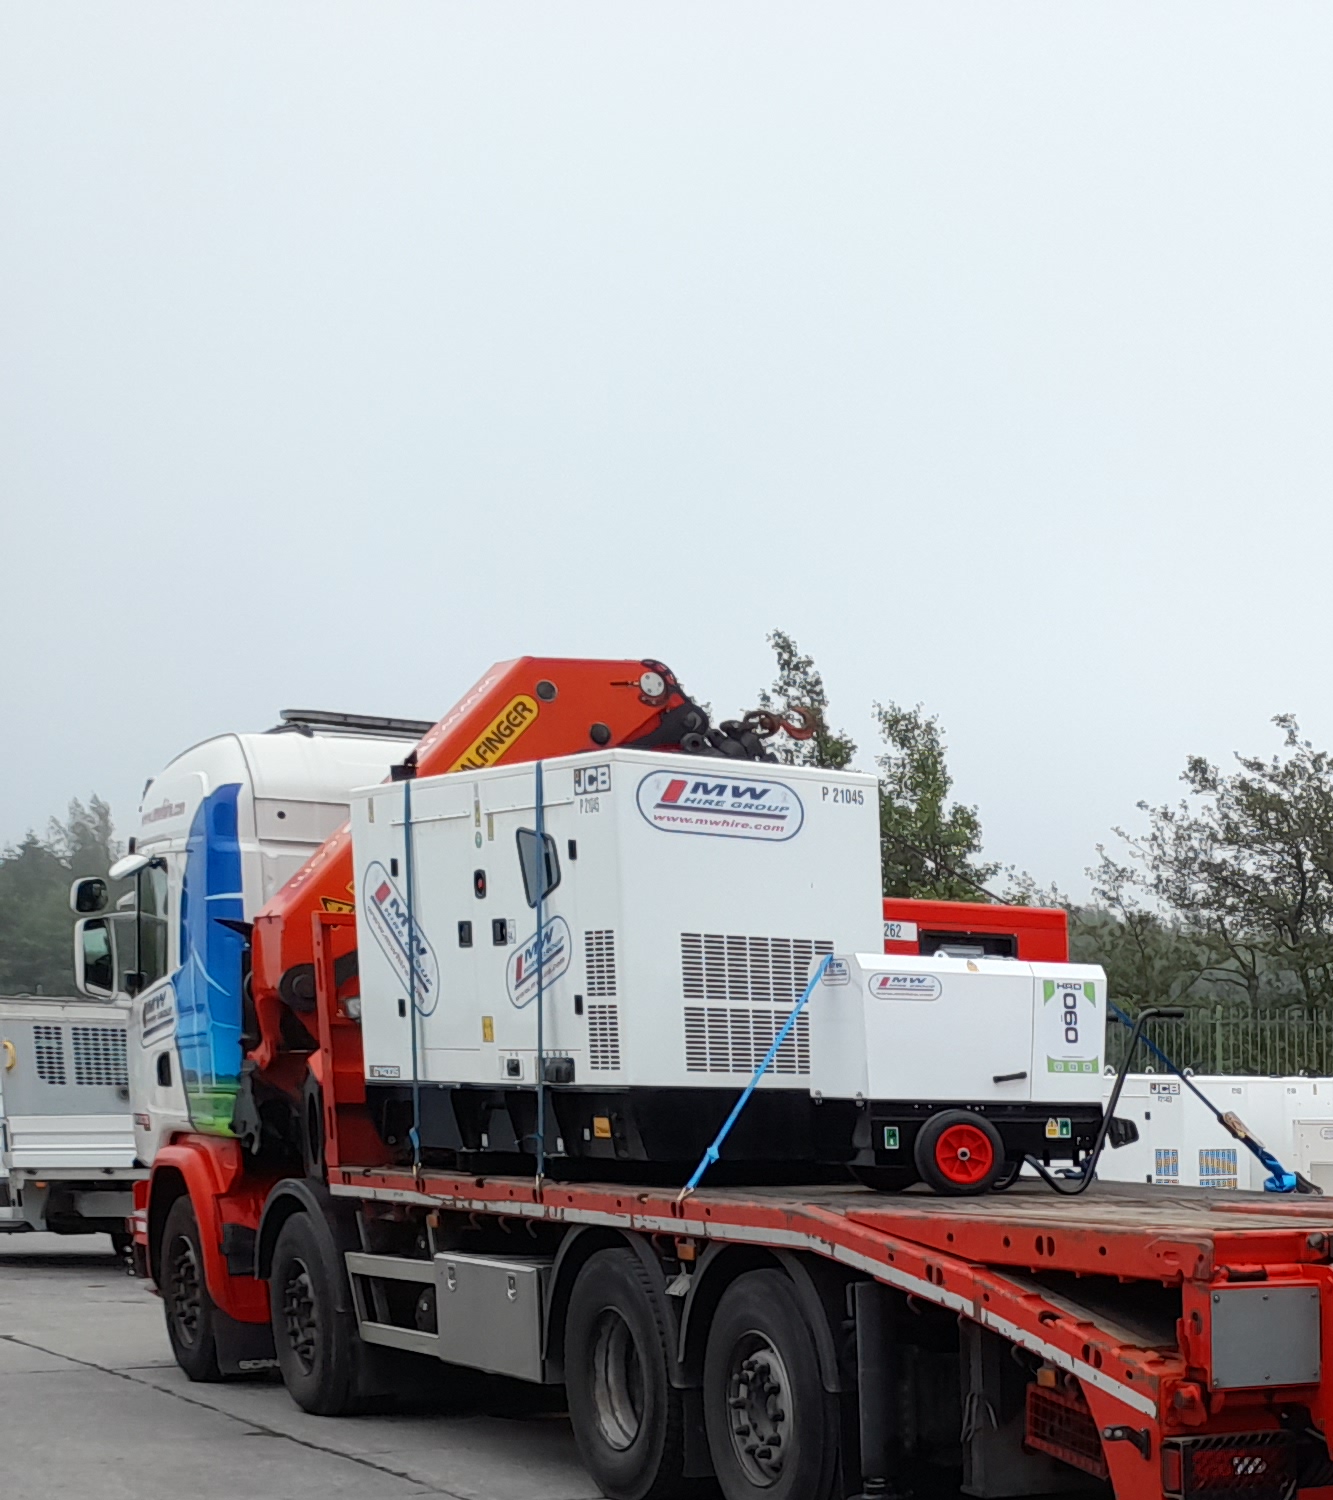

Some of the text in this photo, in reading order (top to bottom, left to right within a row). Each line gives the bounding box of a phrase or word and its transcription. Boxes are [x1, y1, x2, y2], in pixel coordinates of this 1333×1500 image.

[457, 701, 534, 772] ALFINGER
[575, 767, 611, 795] JCB
[689, 780, 771, 801] MW
[683, 797, 791, 814] HIRE GROUP
[822, 787, 865, 806] P 21045
[652, 813, 786, 834] www.mwhire.com
[1151, 1084, 1179, 1094] JCB
